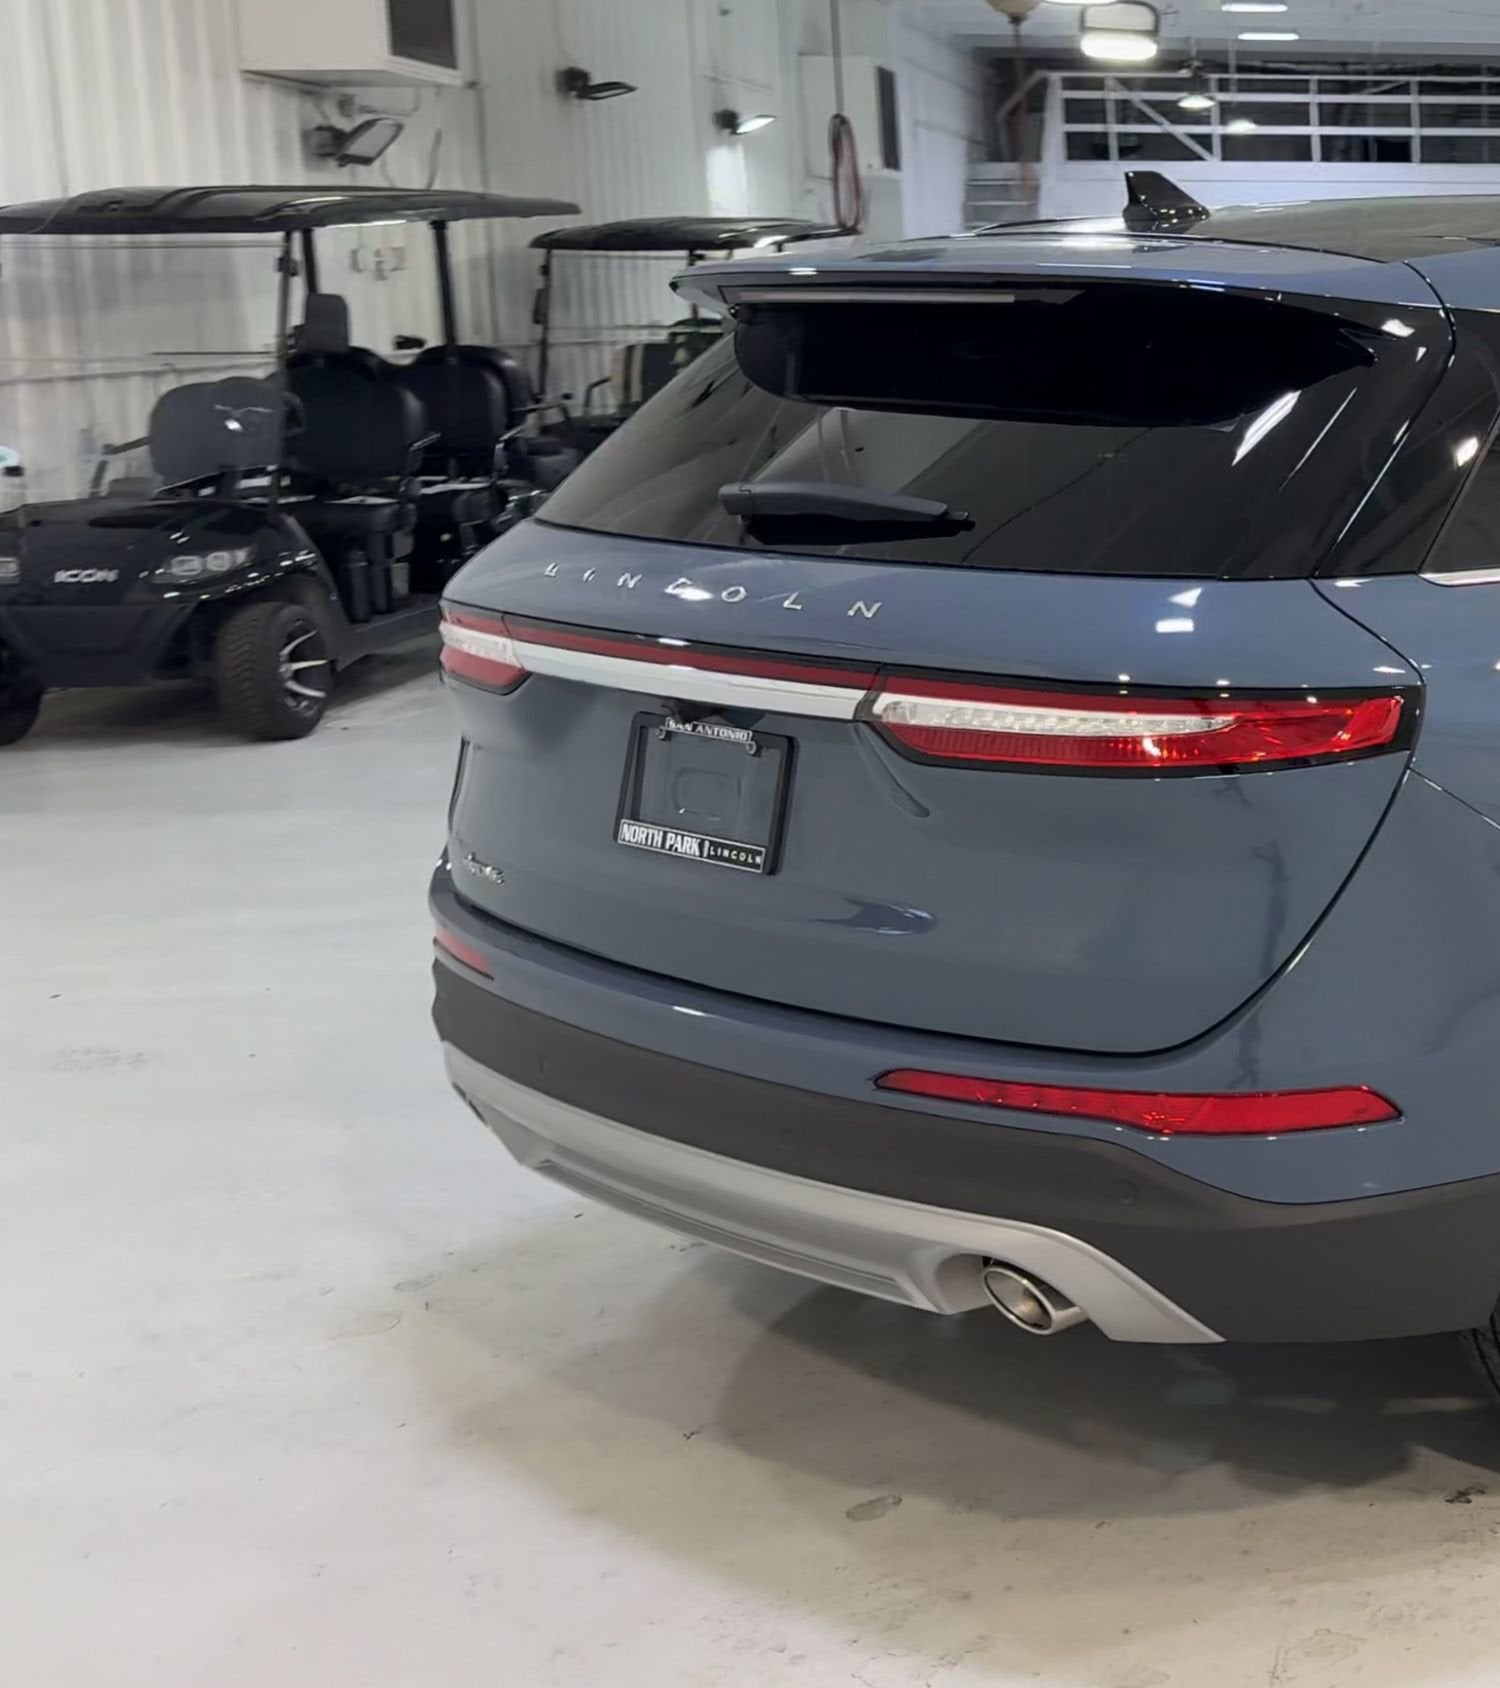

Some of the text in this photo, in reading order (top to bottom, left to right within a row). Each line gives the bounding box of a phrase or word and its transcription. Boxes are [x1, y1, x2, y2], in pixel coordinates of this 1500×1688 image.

[54, 568, 119, 584] ICON
[695, 724, 748, 741] ANTONIO
[620, 823, 762, 864] NORTH PARK LINCOLN
